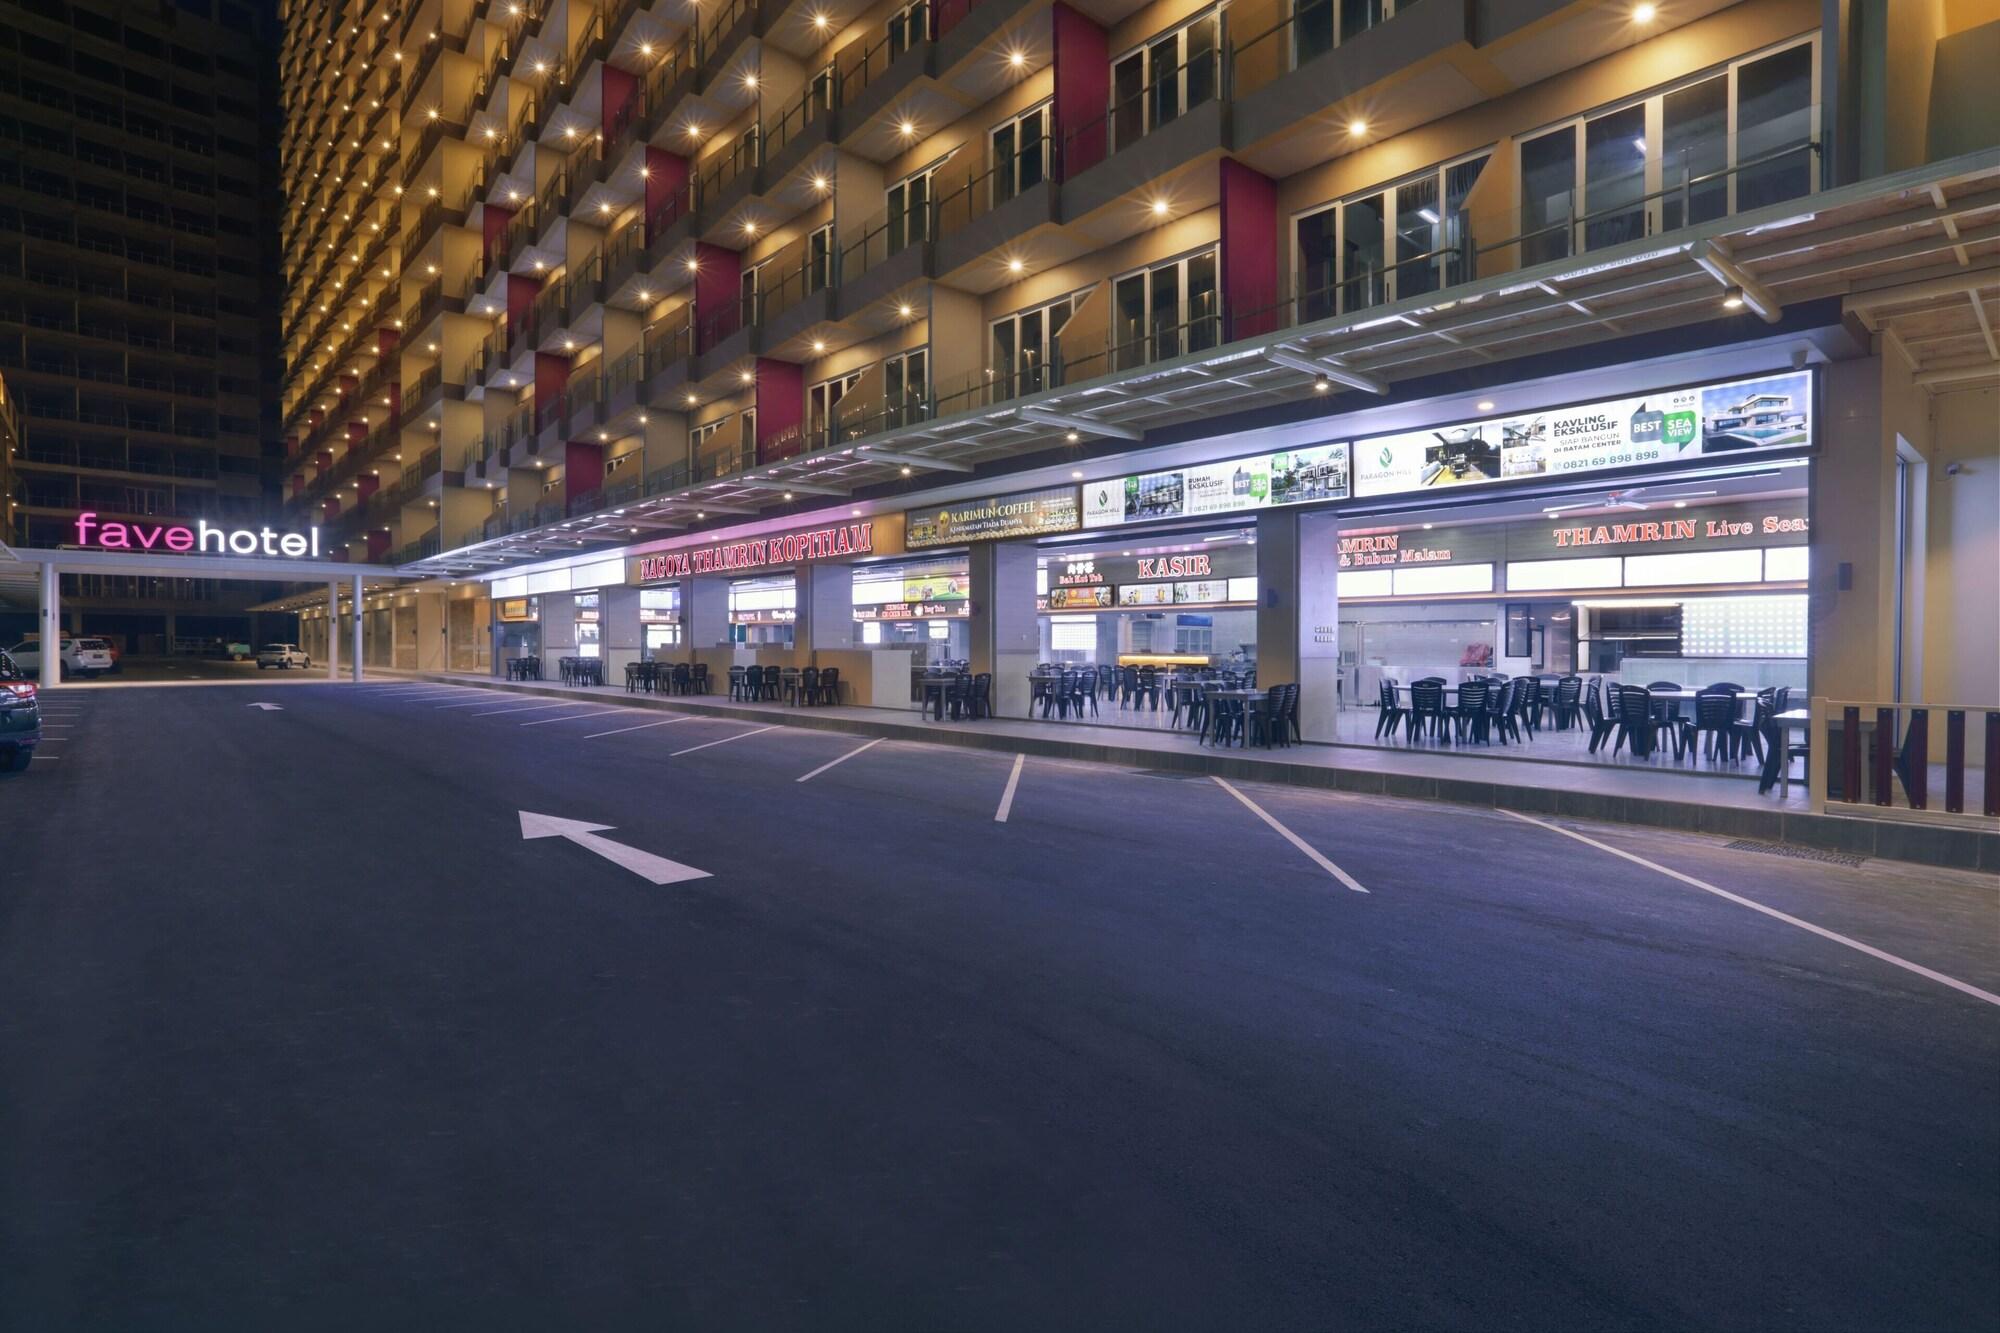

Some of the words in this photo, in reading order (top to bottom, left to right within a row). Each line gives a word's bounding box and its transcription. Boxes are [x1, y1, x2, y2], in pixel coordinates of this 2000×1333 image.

[1554, 415, 1606, 430] KAVLING
[1554, 421, 1618, 437] EKSKLUSIF
[1634, 420, 1662, 433] BEST
[1667, 418, 1692, 429] SEA
[1667, 427, 1692, 437] VIEW
[1563, 444, 1590, 452] BATAM
[1592, 440, 1621, 448] CENTER
[1563, 459, 1588, 469] 0821
[1592, 457, 1606, 466] 69
[1609, 454, 1632, 464] 898
[1635, 450, 1659, 460] 898
[1188, 480, 1225, 490] EKSKLUSIF
[951, 507, 997, 522] KARIMUN
[998, 501, 1036, 517] COFFEE
[75, 512, 319, 557] favehotel
[1554, 520, 1697, 547] THAMRIN
[1706, 520, 1754, 537] Live
[640, 553, 690, 580] NAGOYA
[693, 539, 766, 574] THAMRIN
[769, 523, 872, 563] KOPITIAM
[1340, 554, 1351, 566] &
[1354, 552, 1397, 566] Bubur
[1400, 548, 1451, 562] Malam
[1138, 554, 1211, 579] KASIR
